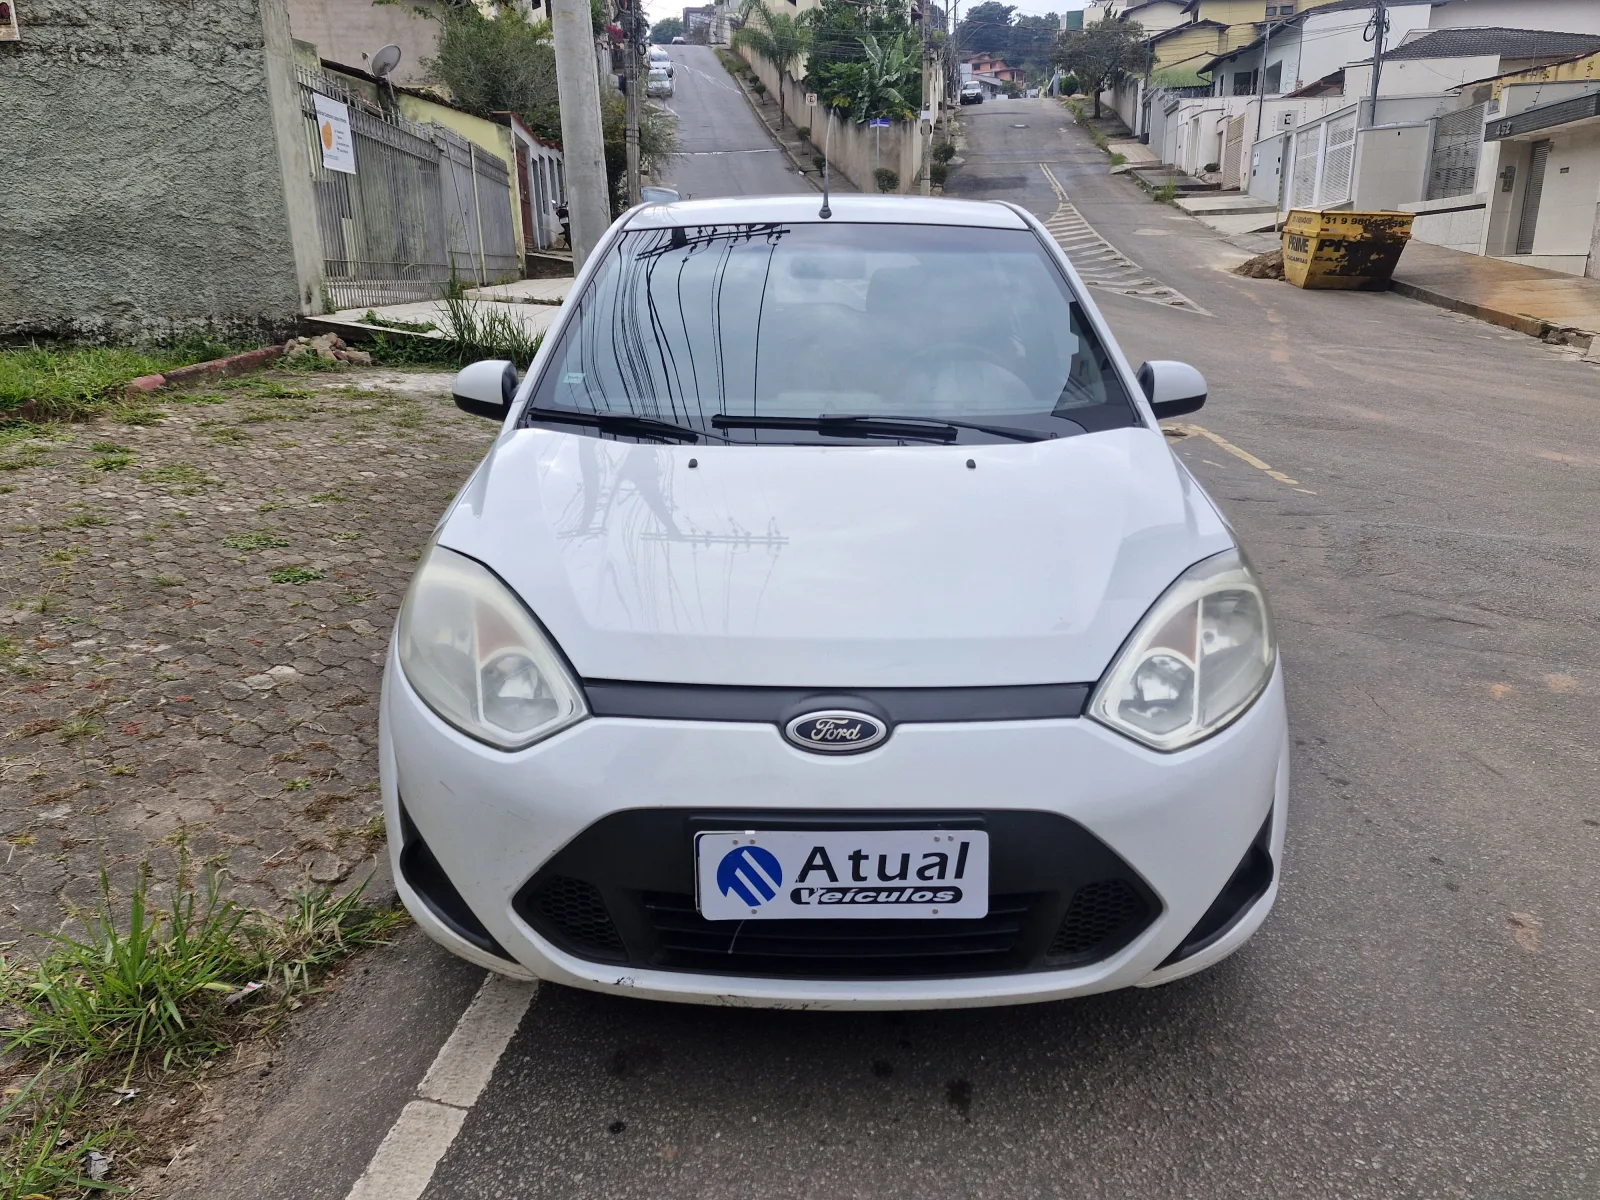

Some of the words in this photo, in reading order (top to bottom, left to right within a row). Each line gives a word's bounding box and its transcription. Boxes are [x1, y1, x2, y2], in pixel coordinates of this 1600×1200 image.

[1325, 217, 1337, 225] 31
[1341, 217, 1348, 225] 9
[1288, 235, 1309, 254] PRIME
[810, 718, 861, 740] Ford
[795, 841, 970, 883] Atual
